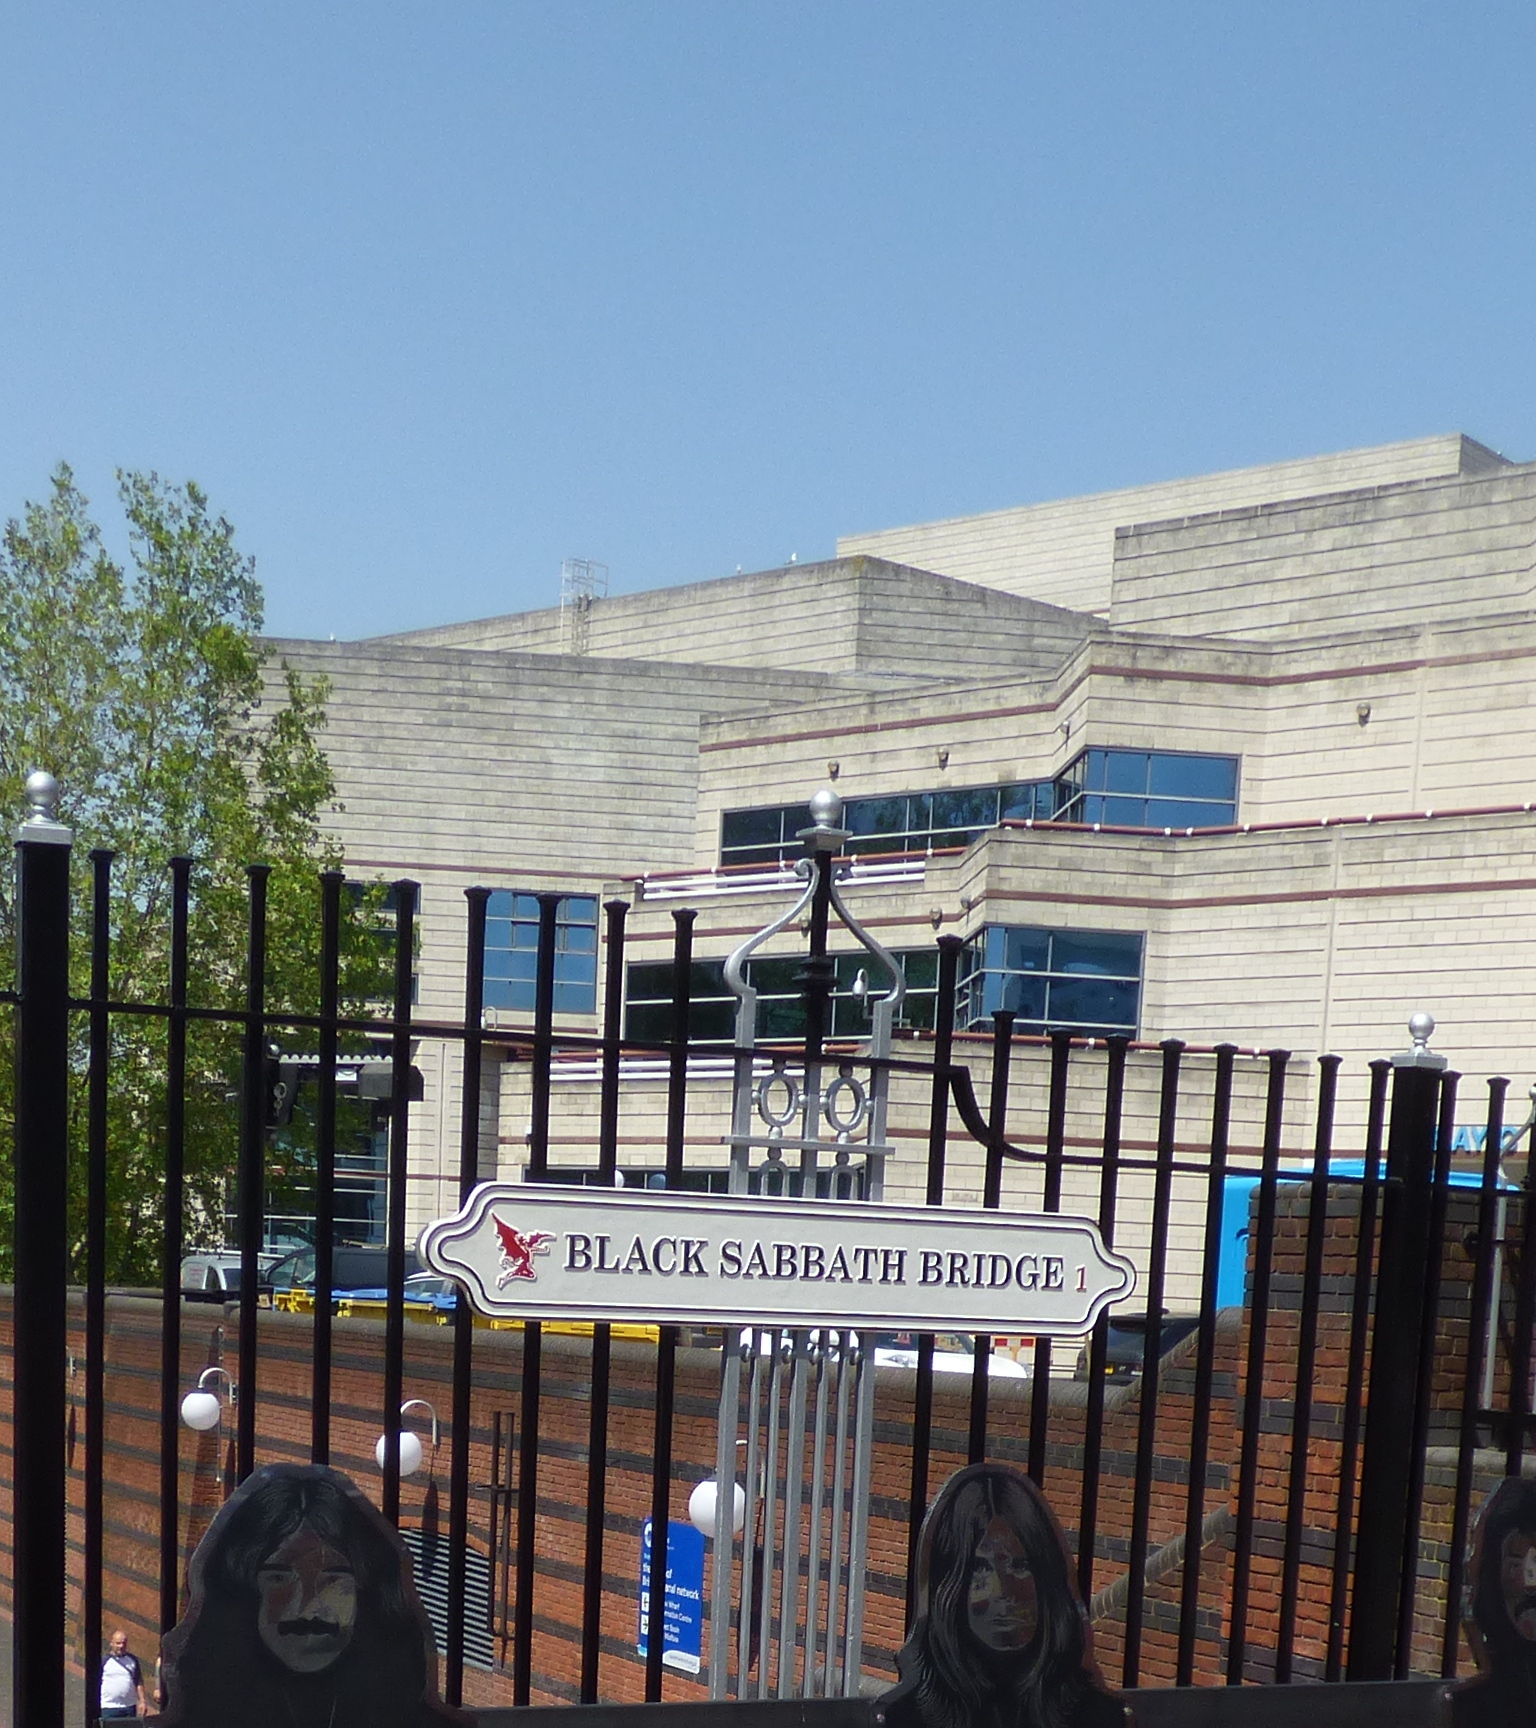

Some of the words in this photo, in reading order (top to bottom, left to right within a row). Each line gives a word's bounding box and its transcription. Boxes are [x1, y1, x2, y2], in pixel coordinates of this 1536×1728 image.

[563, 1233, 709, 1276] BLACK
[719, 1241, 908, 1285] SABBATH
[917, 1250, 1065, 1292] BRIDGE
[1074, 1266, 1087, 1292] 1
[676, 1586, 700, 1601] network
